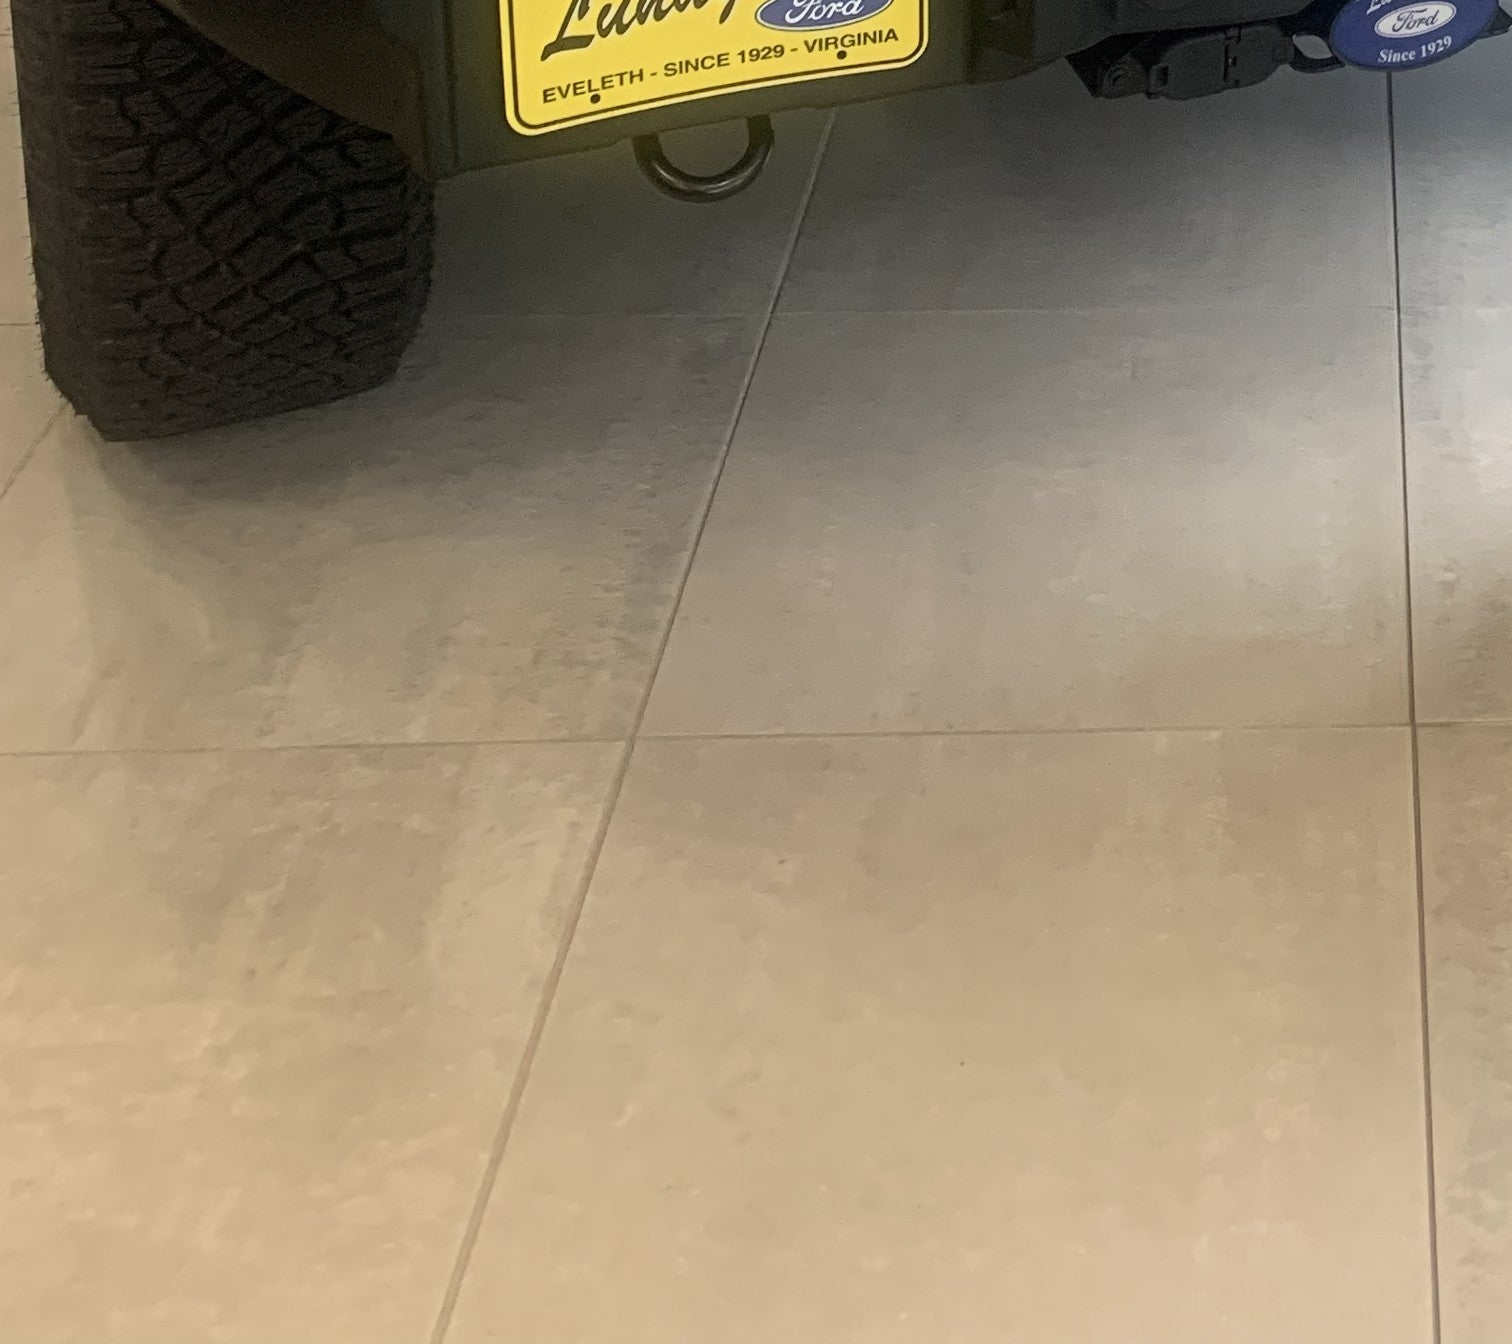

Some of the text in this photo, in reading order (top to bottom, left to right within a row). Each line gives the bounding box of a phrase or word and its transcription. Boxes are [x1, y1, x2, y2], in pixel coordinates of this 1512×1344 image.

[1392, 7, 1440, 33] Ford
[1377, 35, 1453, 63] Since 1929
[541, 68, 645, 105] EVELETH
[663, 52, 731, 78] SINCE
[737, 44, 785, 65] 1929
[803, 27, 899, 55] VIRGINIA
